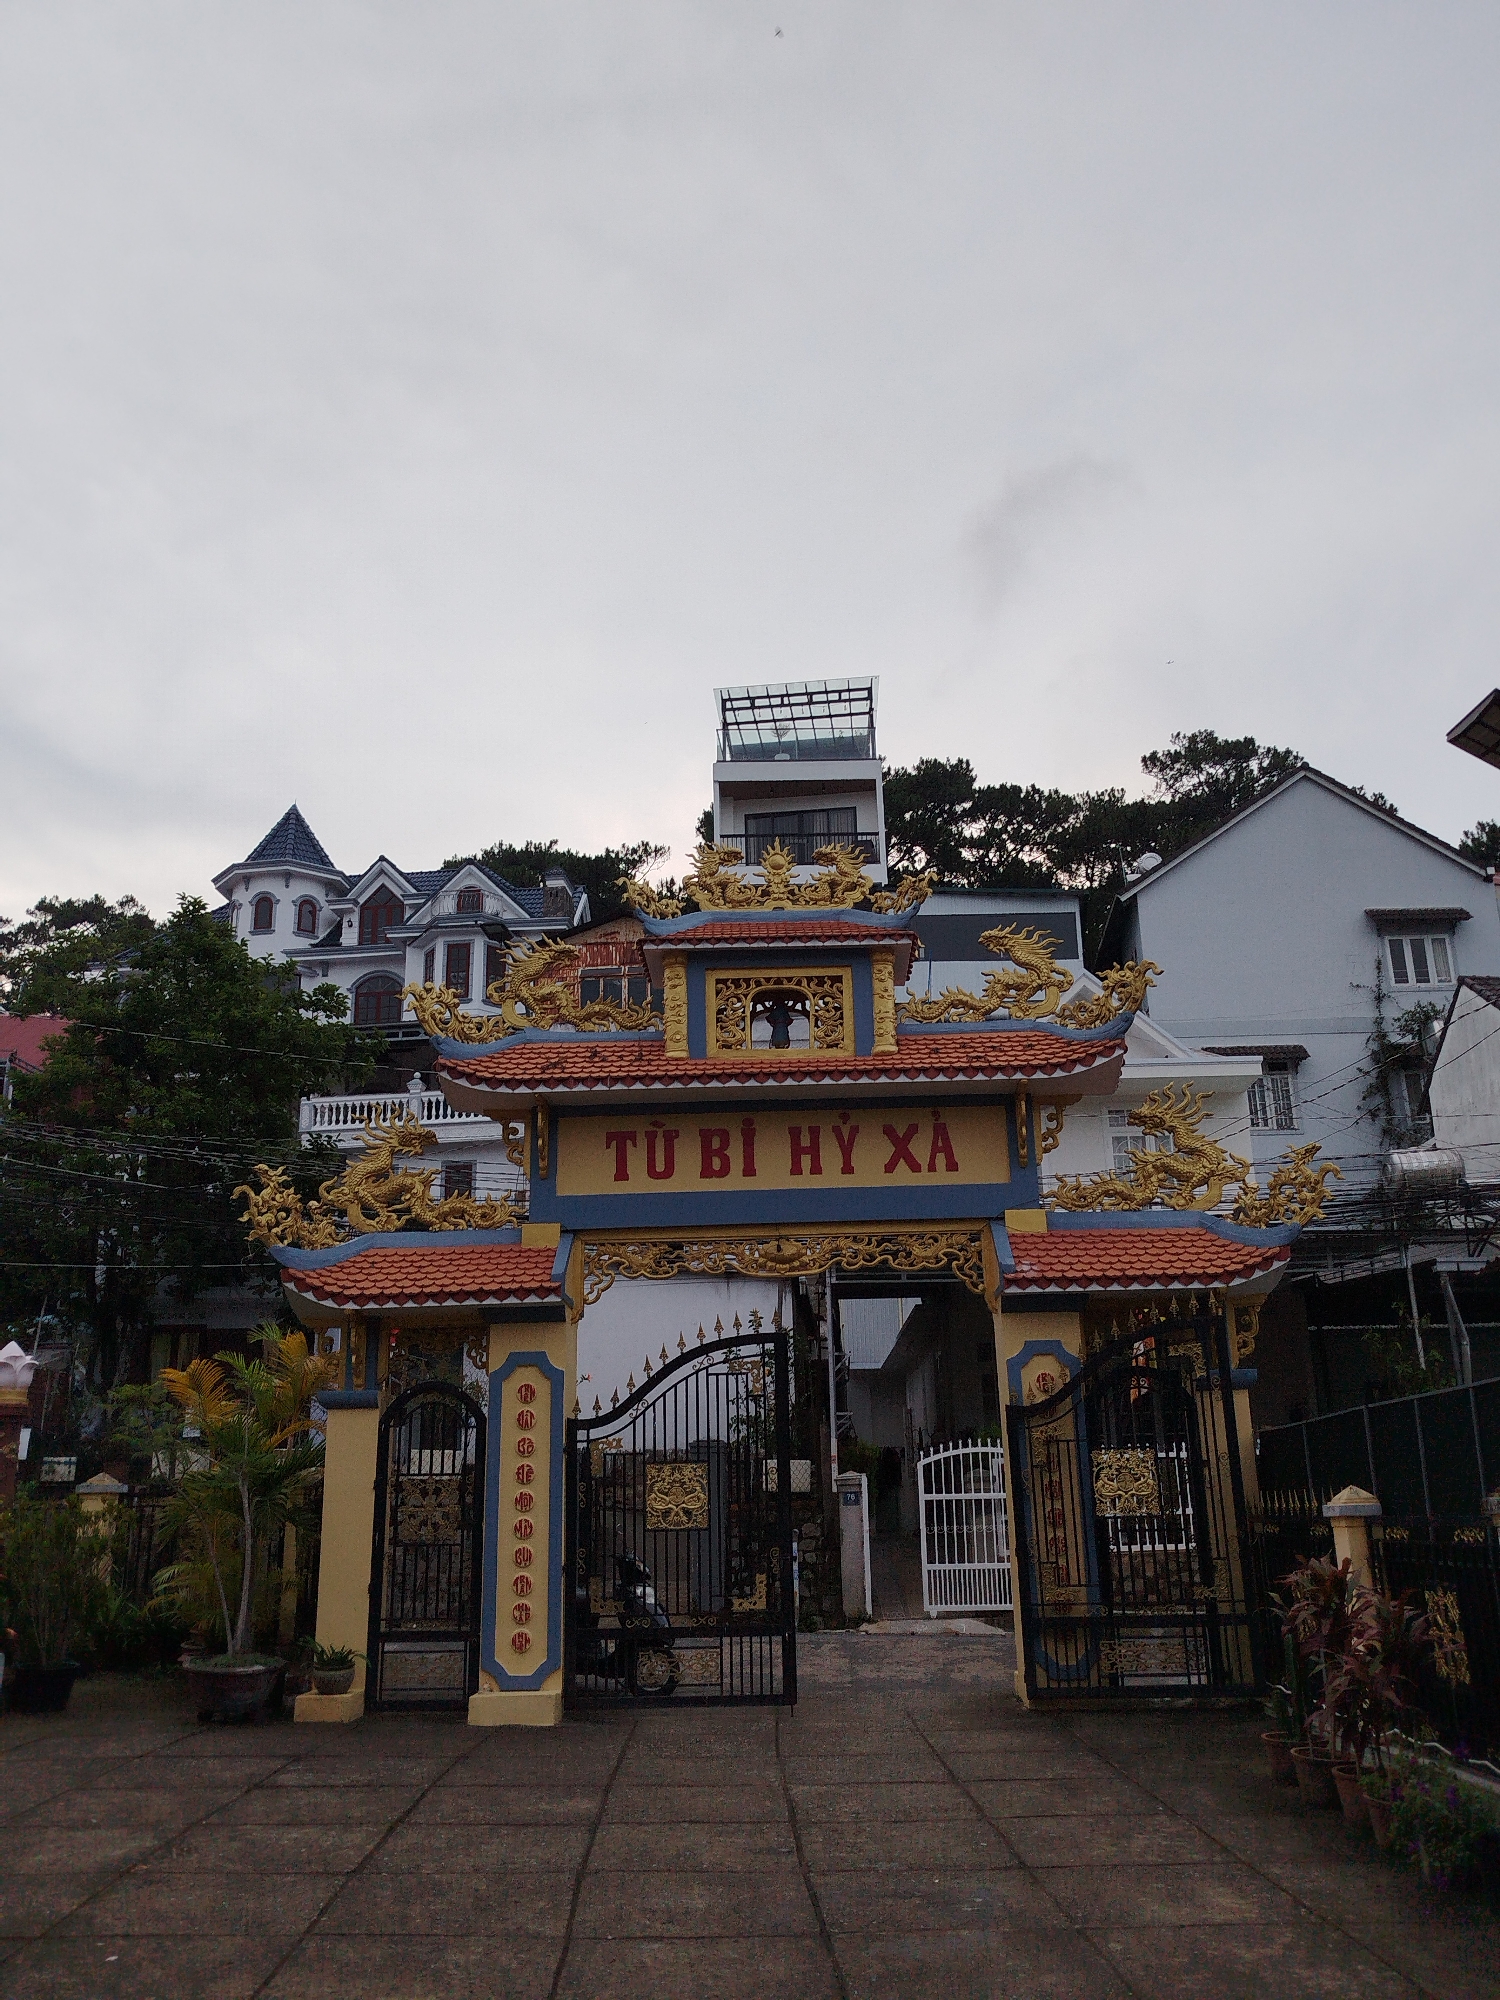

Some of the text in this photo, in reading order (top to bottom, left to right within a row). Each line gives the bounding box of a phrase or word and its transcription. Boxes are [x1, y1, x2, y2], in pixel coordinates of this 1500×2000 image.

[606, 1120, 680, 1181] TỪ
[788, 1112, 860, 1175] HỶ
[883, 1109, 959, 1174] XẢ
[846, 1493, 856, 1501] 76
